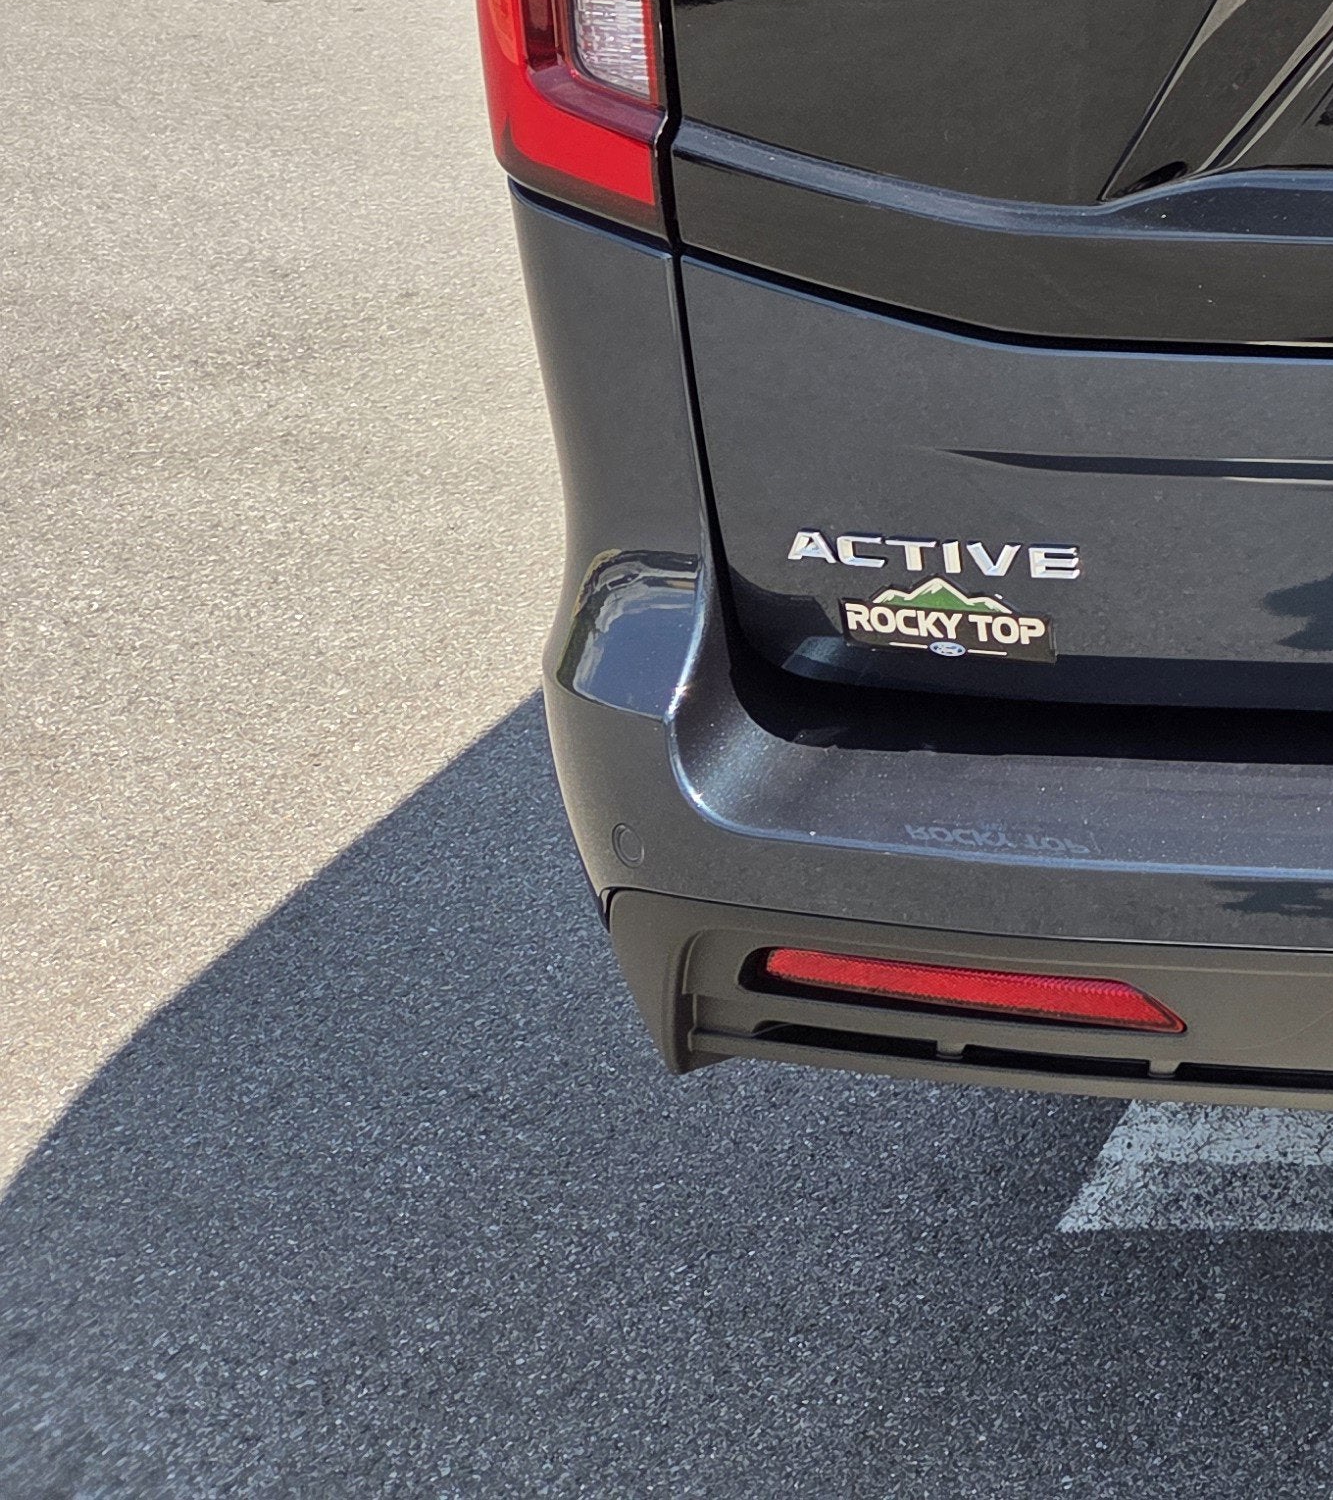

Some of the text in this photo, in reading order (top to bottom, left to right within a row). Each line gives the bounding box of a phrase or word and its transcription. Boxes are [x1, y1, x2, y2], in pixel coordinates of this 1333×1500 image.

[787, 531, 1081, 579] ACTIVE
[844, 602, 1046, 645] ROCKY TOP
